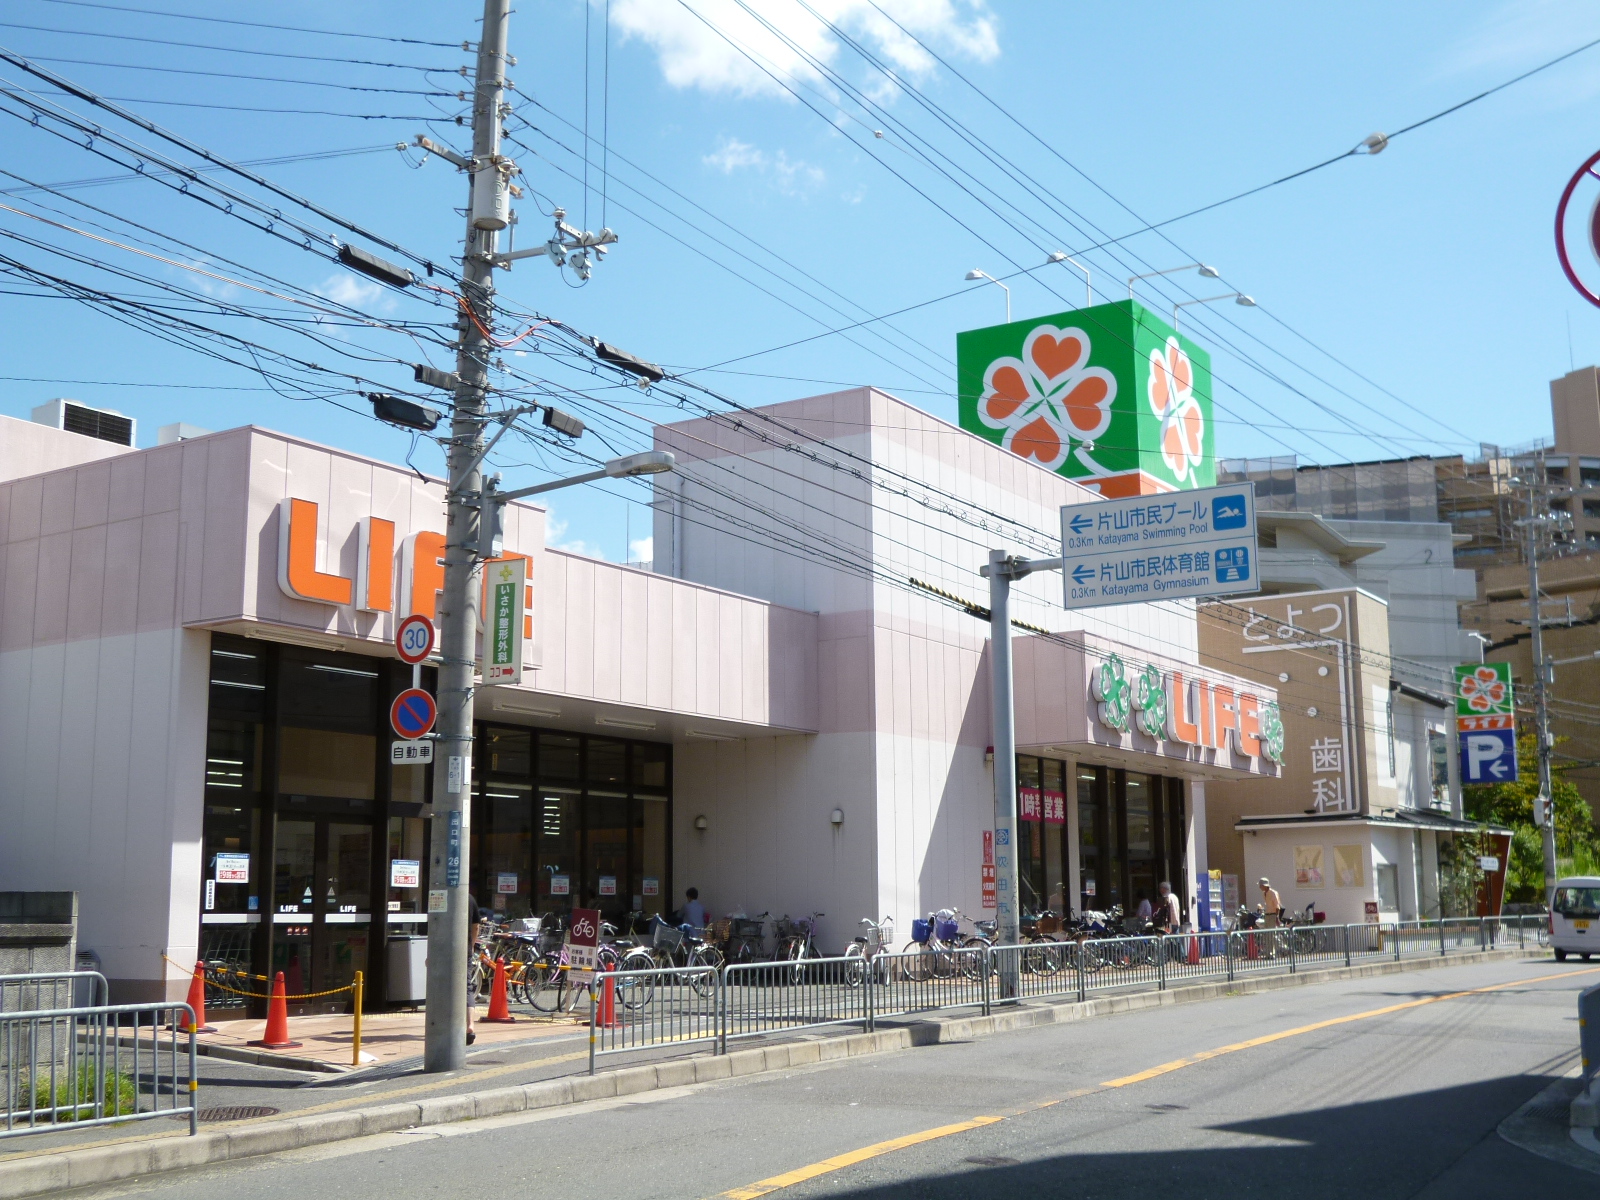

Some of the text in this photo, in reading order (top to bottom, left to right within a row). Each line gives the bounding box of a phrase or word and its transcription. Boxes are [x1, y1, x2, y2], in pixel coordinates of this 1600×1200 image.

[1098, 502, 1208, 531] 片山市民プール
[1069, 522, 1208, 549] 0.3Km Katayama Swimming Pool
[1100, 551, 1210, 581] 片山市民体育館
[1071, 576, 1209, 599] 0.3Km Katayama Gymnasium
[497, 585, 510, 663] いさか整形外科
[1243, 603, 1342, 641] とよつ
[405, 627, 427, 650] 30
[490, 667, 501, 678] ココ
[1165, 671, 1260, 757] LIFE
[1464, 716, 1506, 729] ライフ
[393, 746, 431, 759] 自動車
[1467, 735, 1504, 780] P
[1310, 736, 1345, 813] 歯科
[997, 856, 1009, 914] 吹田市
[280, 904, 298, 913] LIFE
[339, 905, 357, 913] LIFE
